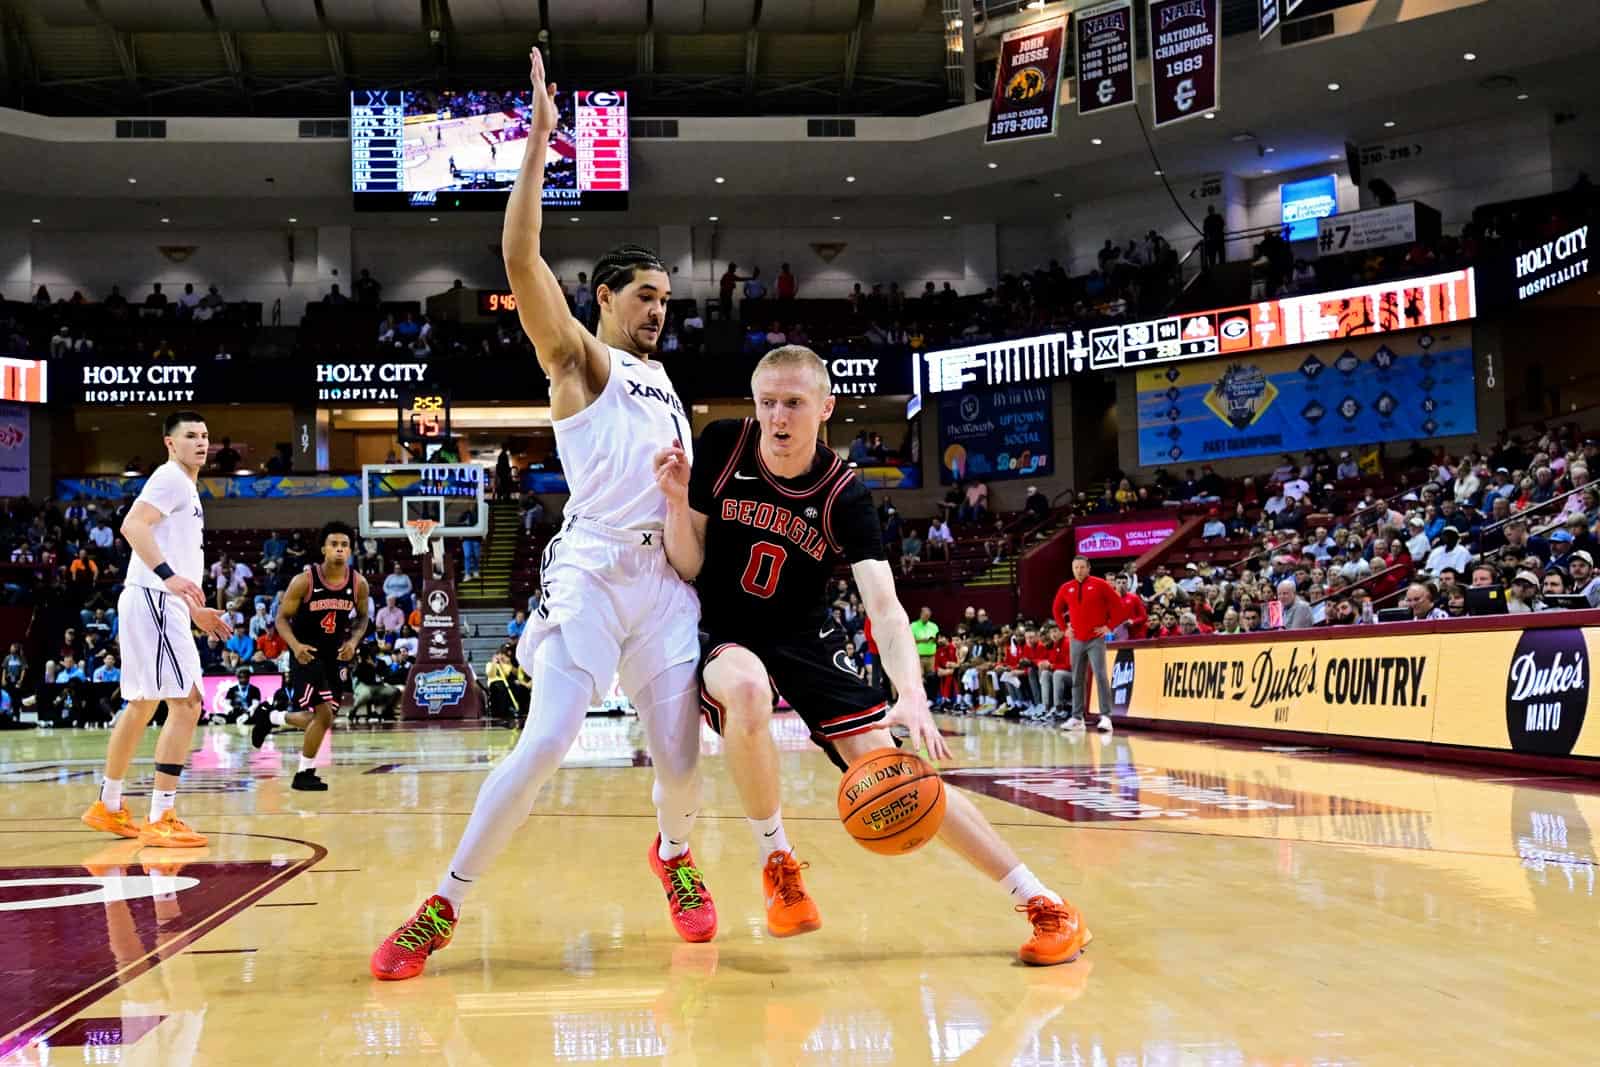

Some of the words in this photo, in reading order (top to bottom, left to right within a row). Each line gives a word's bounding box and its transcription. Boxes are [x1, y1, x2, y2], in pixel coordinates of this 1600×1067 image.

[1019, 35, 1045, 53] JOHN
[1159, 22, 1208, 46] NATIONAL
[1011, 47, 1050, 67] KRESSE
[1155, 34, 1213, 60] CHAMPIONS
[1166, 54, 1203, 78] 1983
[991, 116, 1048, 136] 1979-2002
[1320, 224, 1351, 252] #7
[1515, 243, 1553, 278] HOLY
[1555, 226, 1589, 263] CITY
[1519, 259, 1589, 300] HOSPITALITY
[83, 366, 143, 384] HOLY
[147, 366, 197, 384] CITY
[316, 364, 375, 383] HOLY
[379, 364, 428, 382] CITY
[831, 358, 879, 377] CITY
[85, 390, 195, 402] HOSPITALITY
[319, 388, 399, 400] HOSPITAL
[413, 397, 443, 411] 2:52
[999, 411, 1045, 426] UPTOWN
[301, 424, 309, 452] 107
[1003, 431, 1041, 446] SOCIAL
[641, 532, 653, 546] X
[721, 498, 828, 561] GEORGIA
[740, 541, 788, 599] 0
[309, 598, 354, 611] GEORGIA
[320, 611, 336, 634] 4
[1162, 661, 1227, 699] WELCOME
[1230, 660, 1245, 689] TO
[1250, 647, 1317, 709] Duke's
[1324, 656, 1427, 707] COUNTRY.
[1511, 650, 1584, 701] Duke's
[1525, 702, 1562, 732] MAYO
[845, 760, 913, 806] SPALDING
[862, 789, 919, 826] LEGACY
